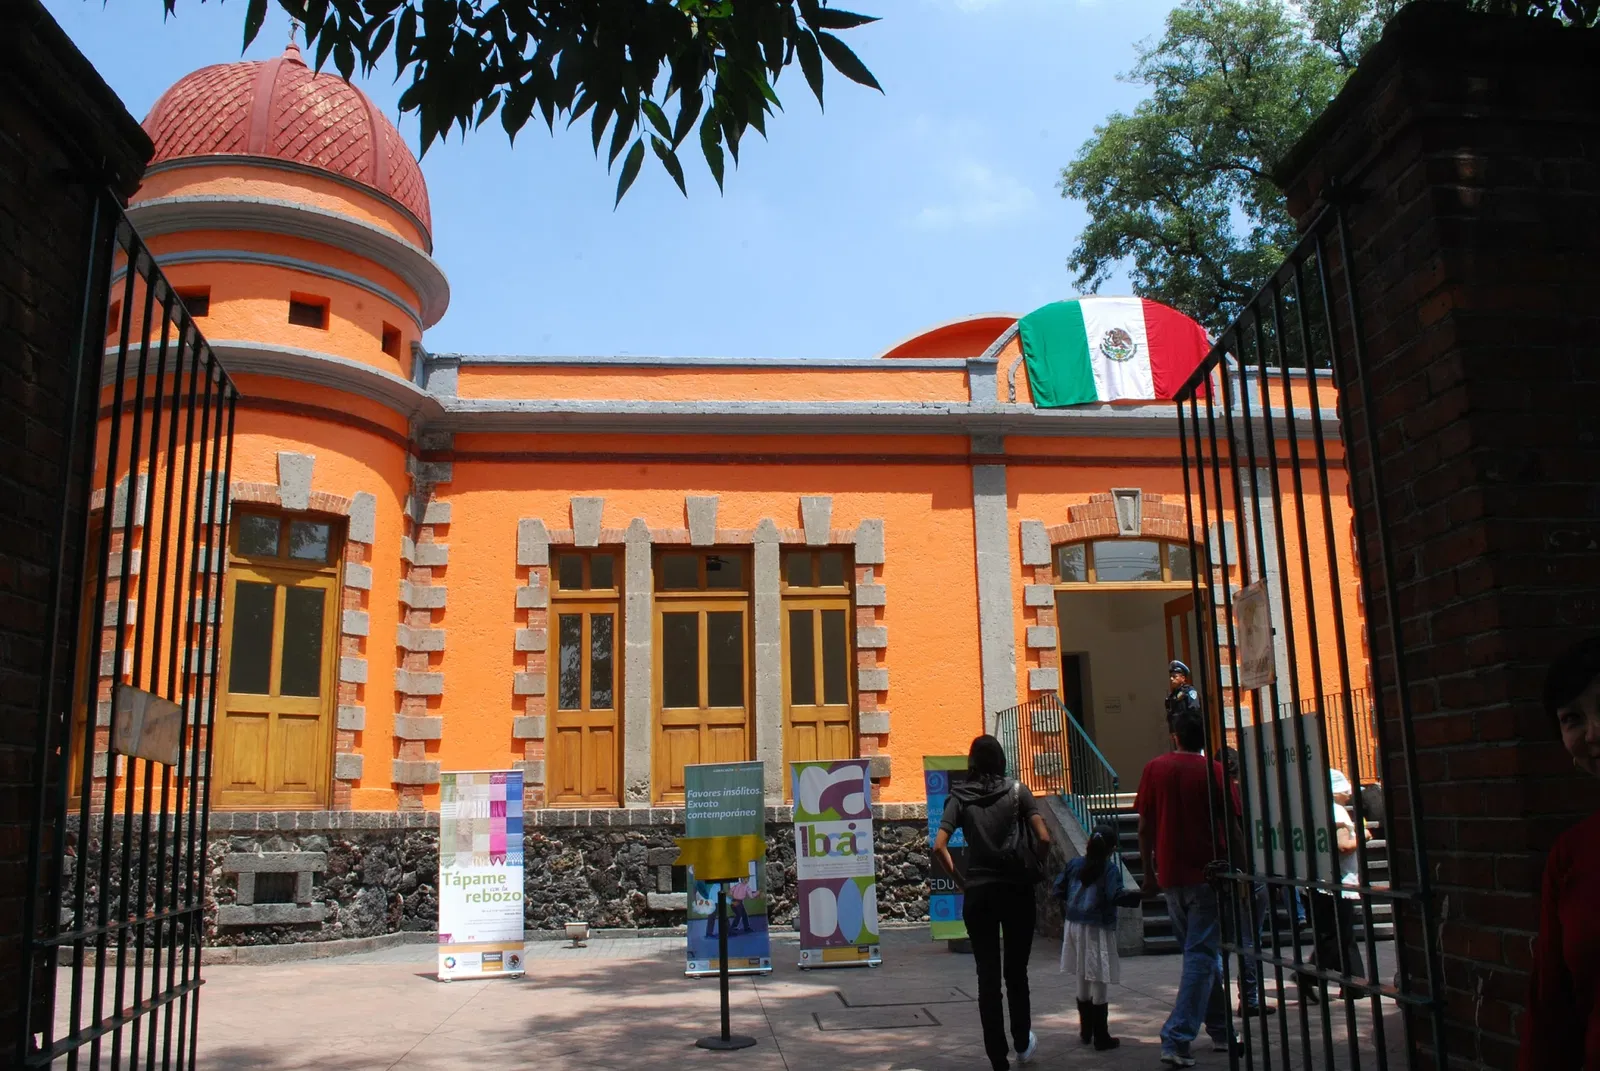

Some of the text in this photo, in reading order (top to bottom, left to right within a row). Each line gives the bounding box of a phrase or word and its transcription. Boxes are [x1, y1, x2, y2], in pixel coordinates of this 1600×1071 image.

[687, 787, 762, 798] Favores insólitos.
[687, 800, 719, 808] Exvoto
[687, 808, 756, 820] contemporáneo
[1255, 819, 1329, 853] Entaa
[442, 871, 507, 890] Tápame
[466, 888, 522, 903] rebozo
